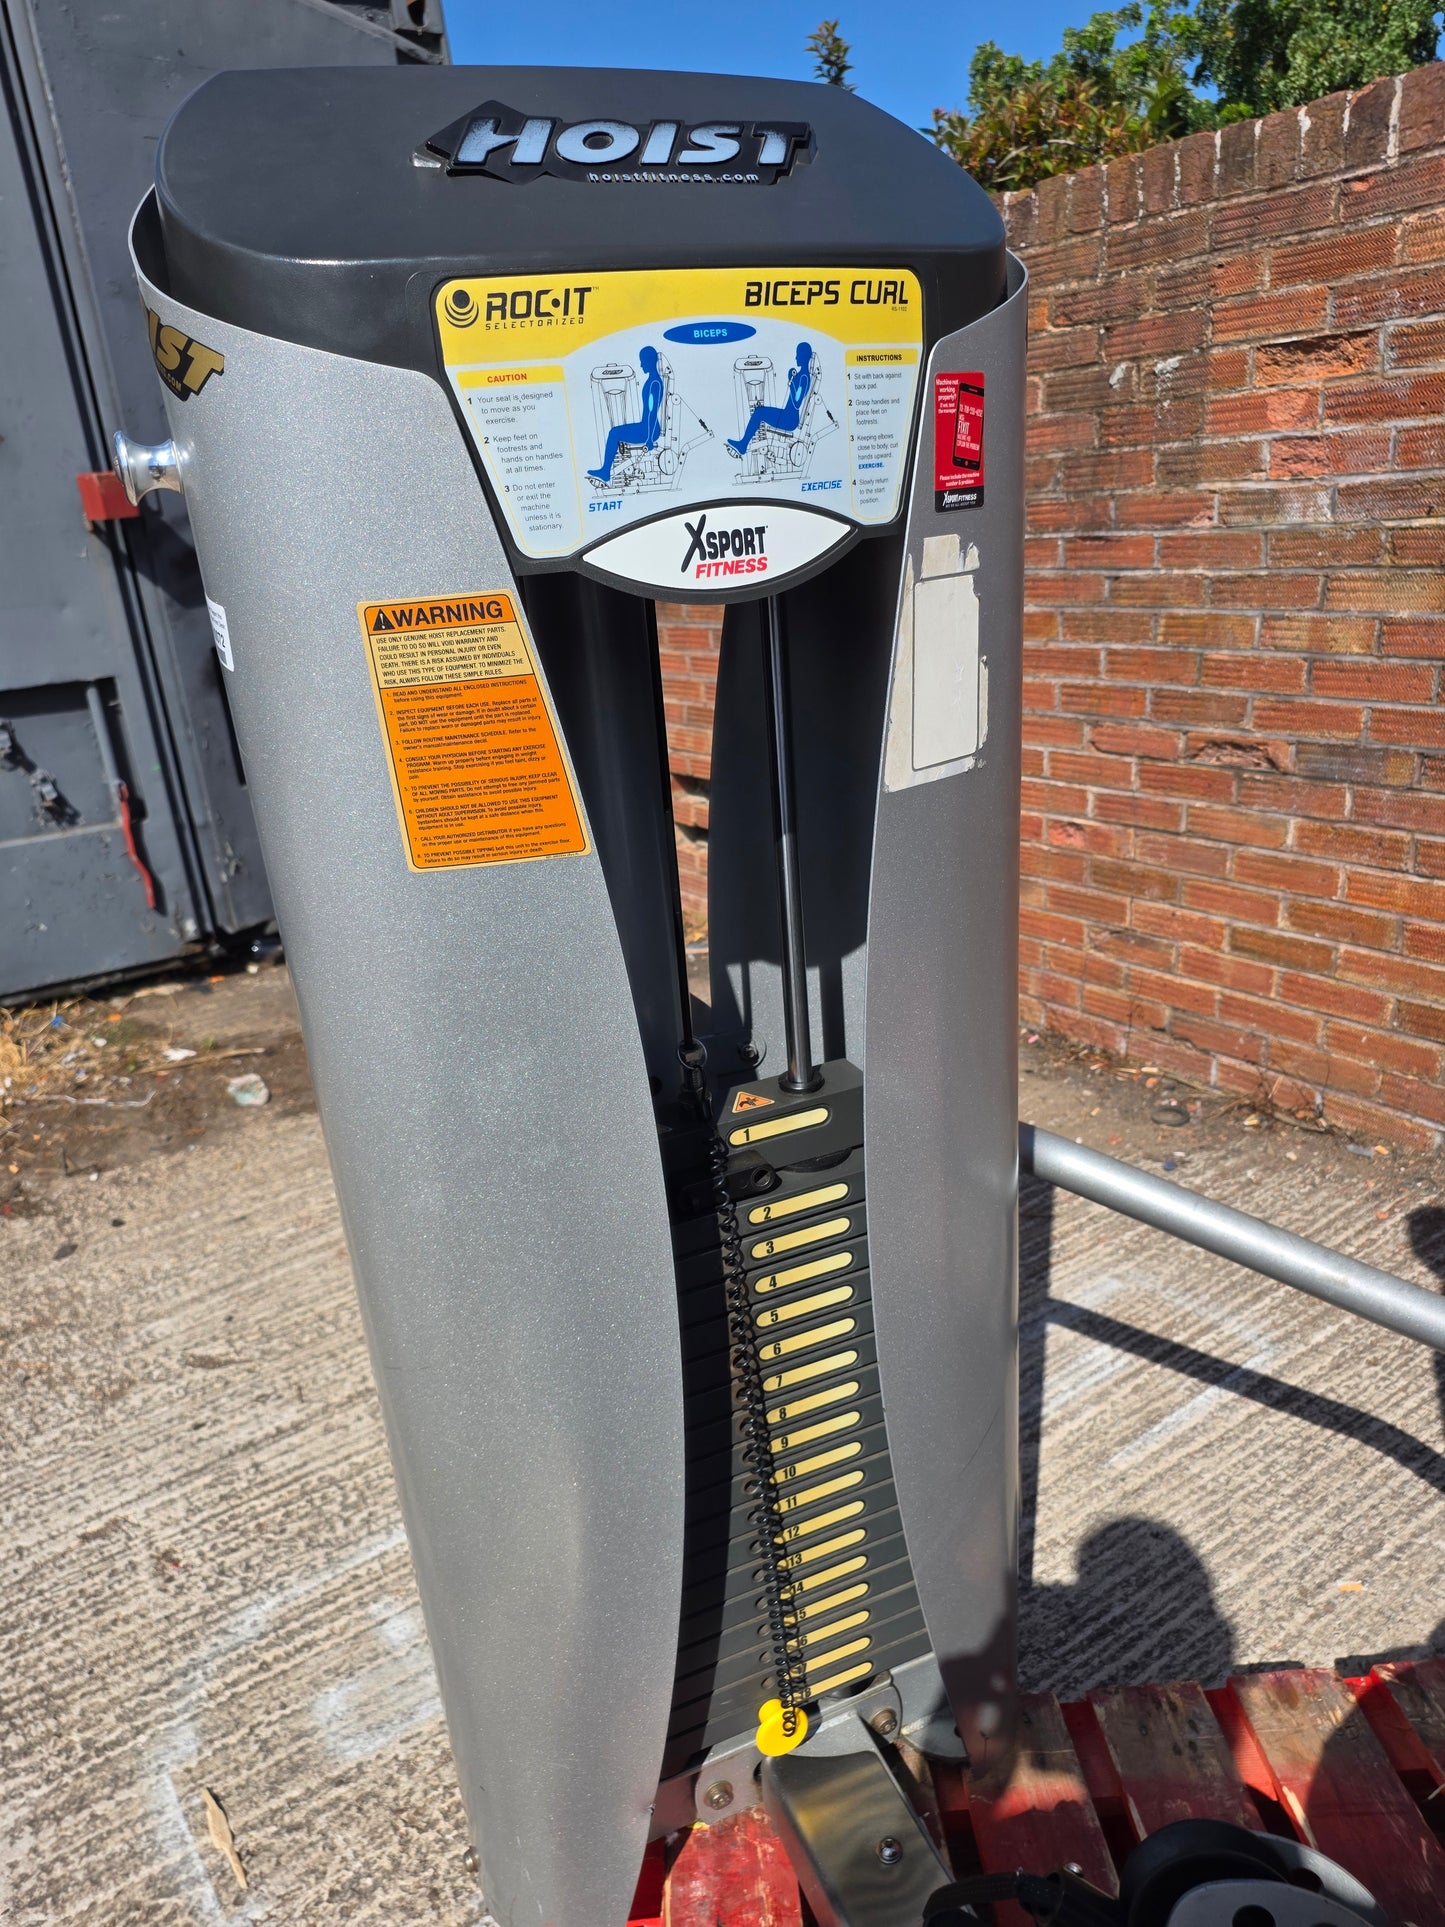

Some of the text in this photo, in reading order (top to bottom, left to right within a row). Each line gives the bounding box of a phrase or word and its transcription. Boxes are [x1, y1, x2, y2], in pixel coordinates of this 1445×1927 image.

[453, 116, 808, 167] HOIST
[588, 172, 760, 184] hoistfitness.com
[745, 280, 908, 306] BICEPS CURL
[486, 316, 584, 330] SELECTORIZED
[693, 329, 727, 338] BICEPS
[856, 354, 902, 362] INSTRUCTIONS
[487, 373, 527, 383] CAUTION
[521, 392, 553, 401] designed
[493, 435, 512, 444] Keep
[857, 434, 877, 442] Keeping
[497, 444, 528, 453] footrests
[536, 452, 563, 460] handles
[801, 480, 842, 492] EXERCISE
[859, 478, 874, 486] Slowly
[588, 500, 623, 512] START
[681, 514, 766, 573] XSPORT
[695, 556, 768, 579] FITNESS
[392, 600, 503, 628] WARNING
[446, 628, 486, 637] REPLACEMENT
[455, 637, 486, 645] WARRANTY
[427, 648, 456, 656] PERSONAL
[482, 651, 515, 659] INDIVIDUALS
[419, 686, 452, 694] UNDERSTAND
[491, 679, 527, 688] INSTRUCTIONS
[743, 1129, 750, 1141] 1
[763, 1207, 771, 1220] 2
[766, 1241, 774, 1253] 3
[769, 1276, 777, 1288] 4
[770, 1310, 778, 1323] 5
[773, 1343, 781, 1355] 6
[776, 1375, 782, 1386] 7
[779, 1408, 787, 1419] 8
[781, 1437, 788, 1448] 9
[783, 1465, 796, 1479] 10
[786, 1496, 797, 1509] 11
[787, 1526, 800, 1539] 12
[790, 1554, 802, 1566] 13
[791, 1581, 803, 1594] 14
[795, 1608, 806, 1621] 15
[796, 1636, 808, 1648] 16
[800, 1688, 811, 1699] 18
